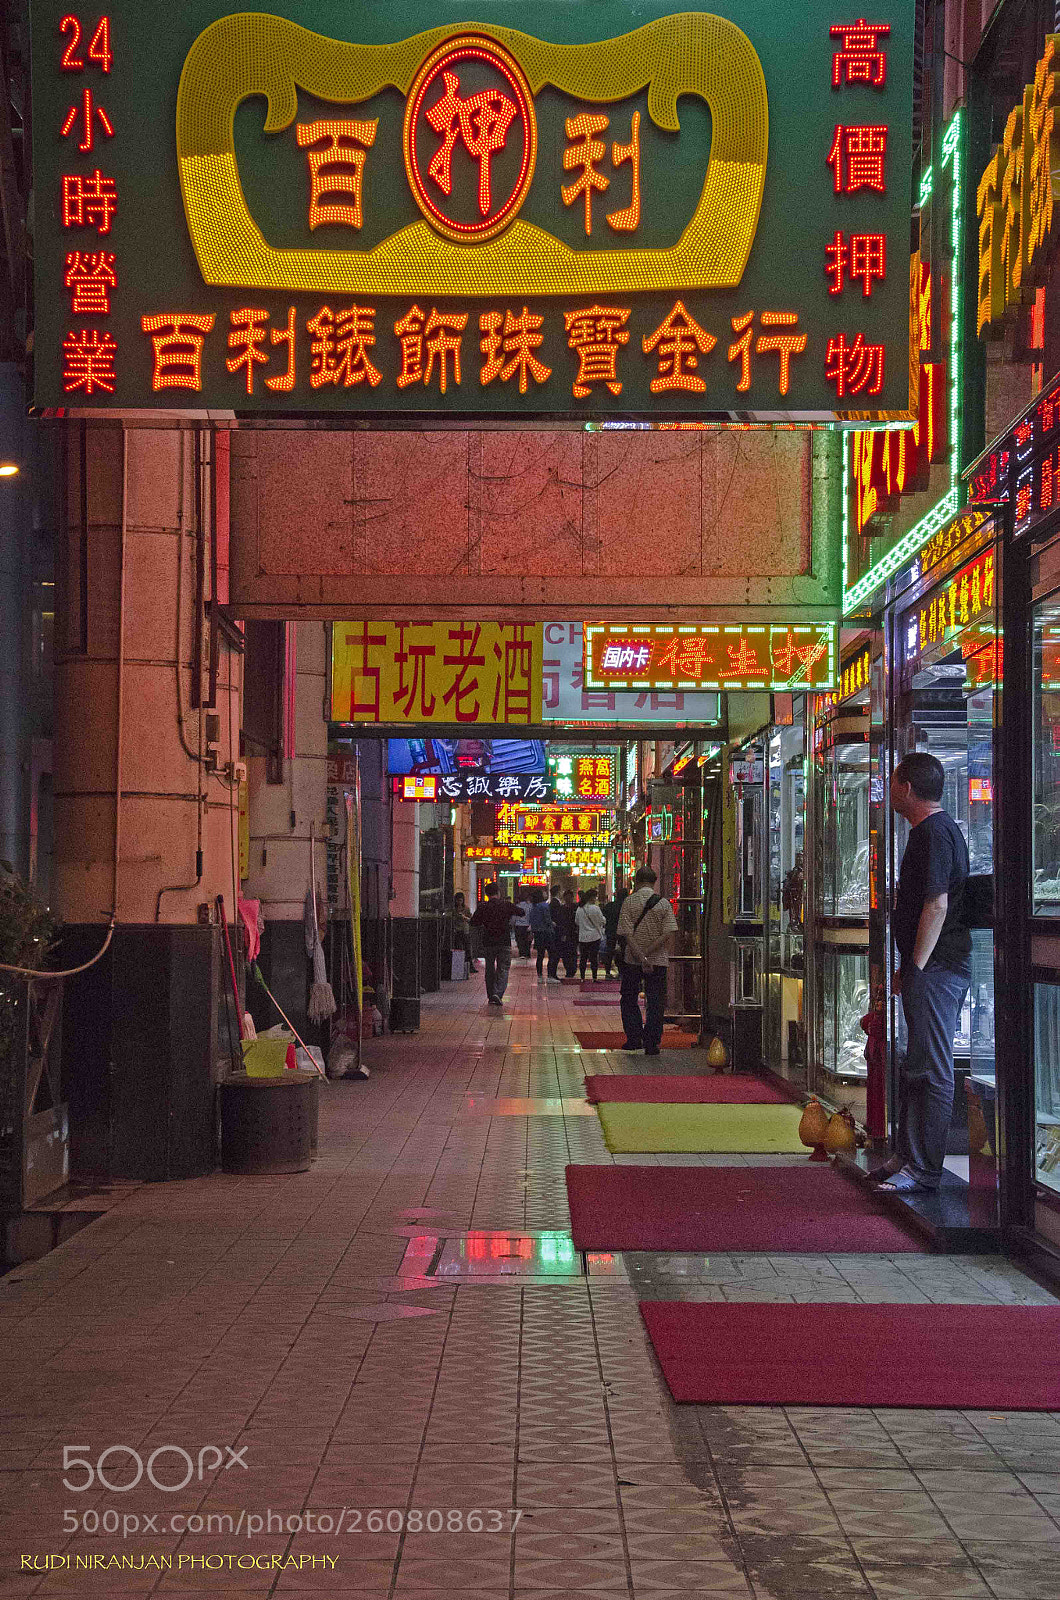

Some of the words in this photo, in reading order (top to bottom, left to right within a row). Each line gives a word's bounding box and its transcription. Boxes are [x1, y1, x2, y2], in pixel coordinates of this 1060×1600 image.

[59, 15, 117, 395] 24小時營業
[824, 19, 891, 397] 高價押物
[140, 299, 807, 399] 百利錶飾珠寶金行
[345, 621, 533, 724] 古玩老酒
[602, 646, 650, 669] 国内卡
[657, 633, 827, 681] 得生押
